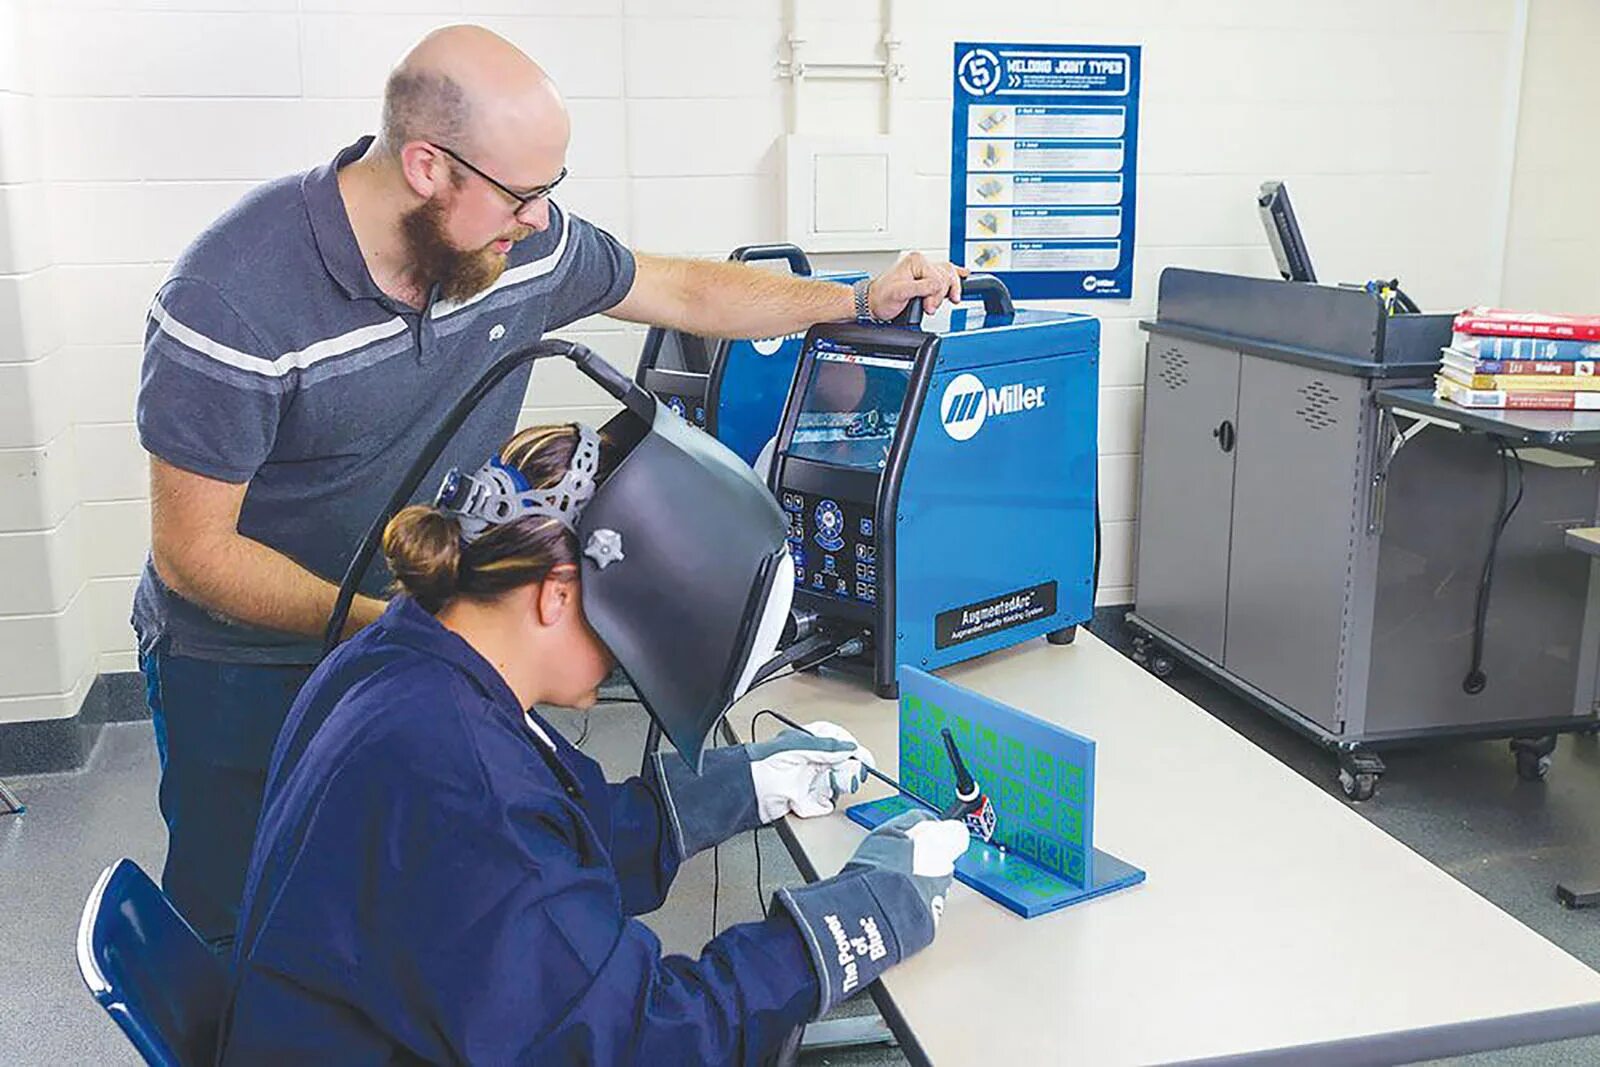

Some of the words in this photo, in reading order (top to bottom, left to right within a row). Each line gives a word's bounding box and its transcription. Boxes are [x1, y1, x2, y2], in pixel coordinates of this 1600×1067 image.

[969, 57, 991, 87] 5
[988, 383, 1046, 416] Miller
[824, 914, 855, 967] Power
[850, 936, 869, 956] of
[843, 960, 858, 993] The
